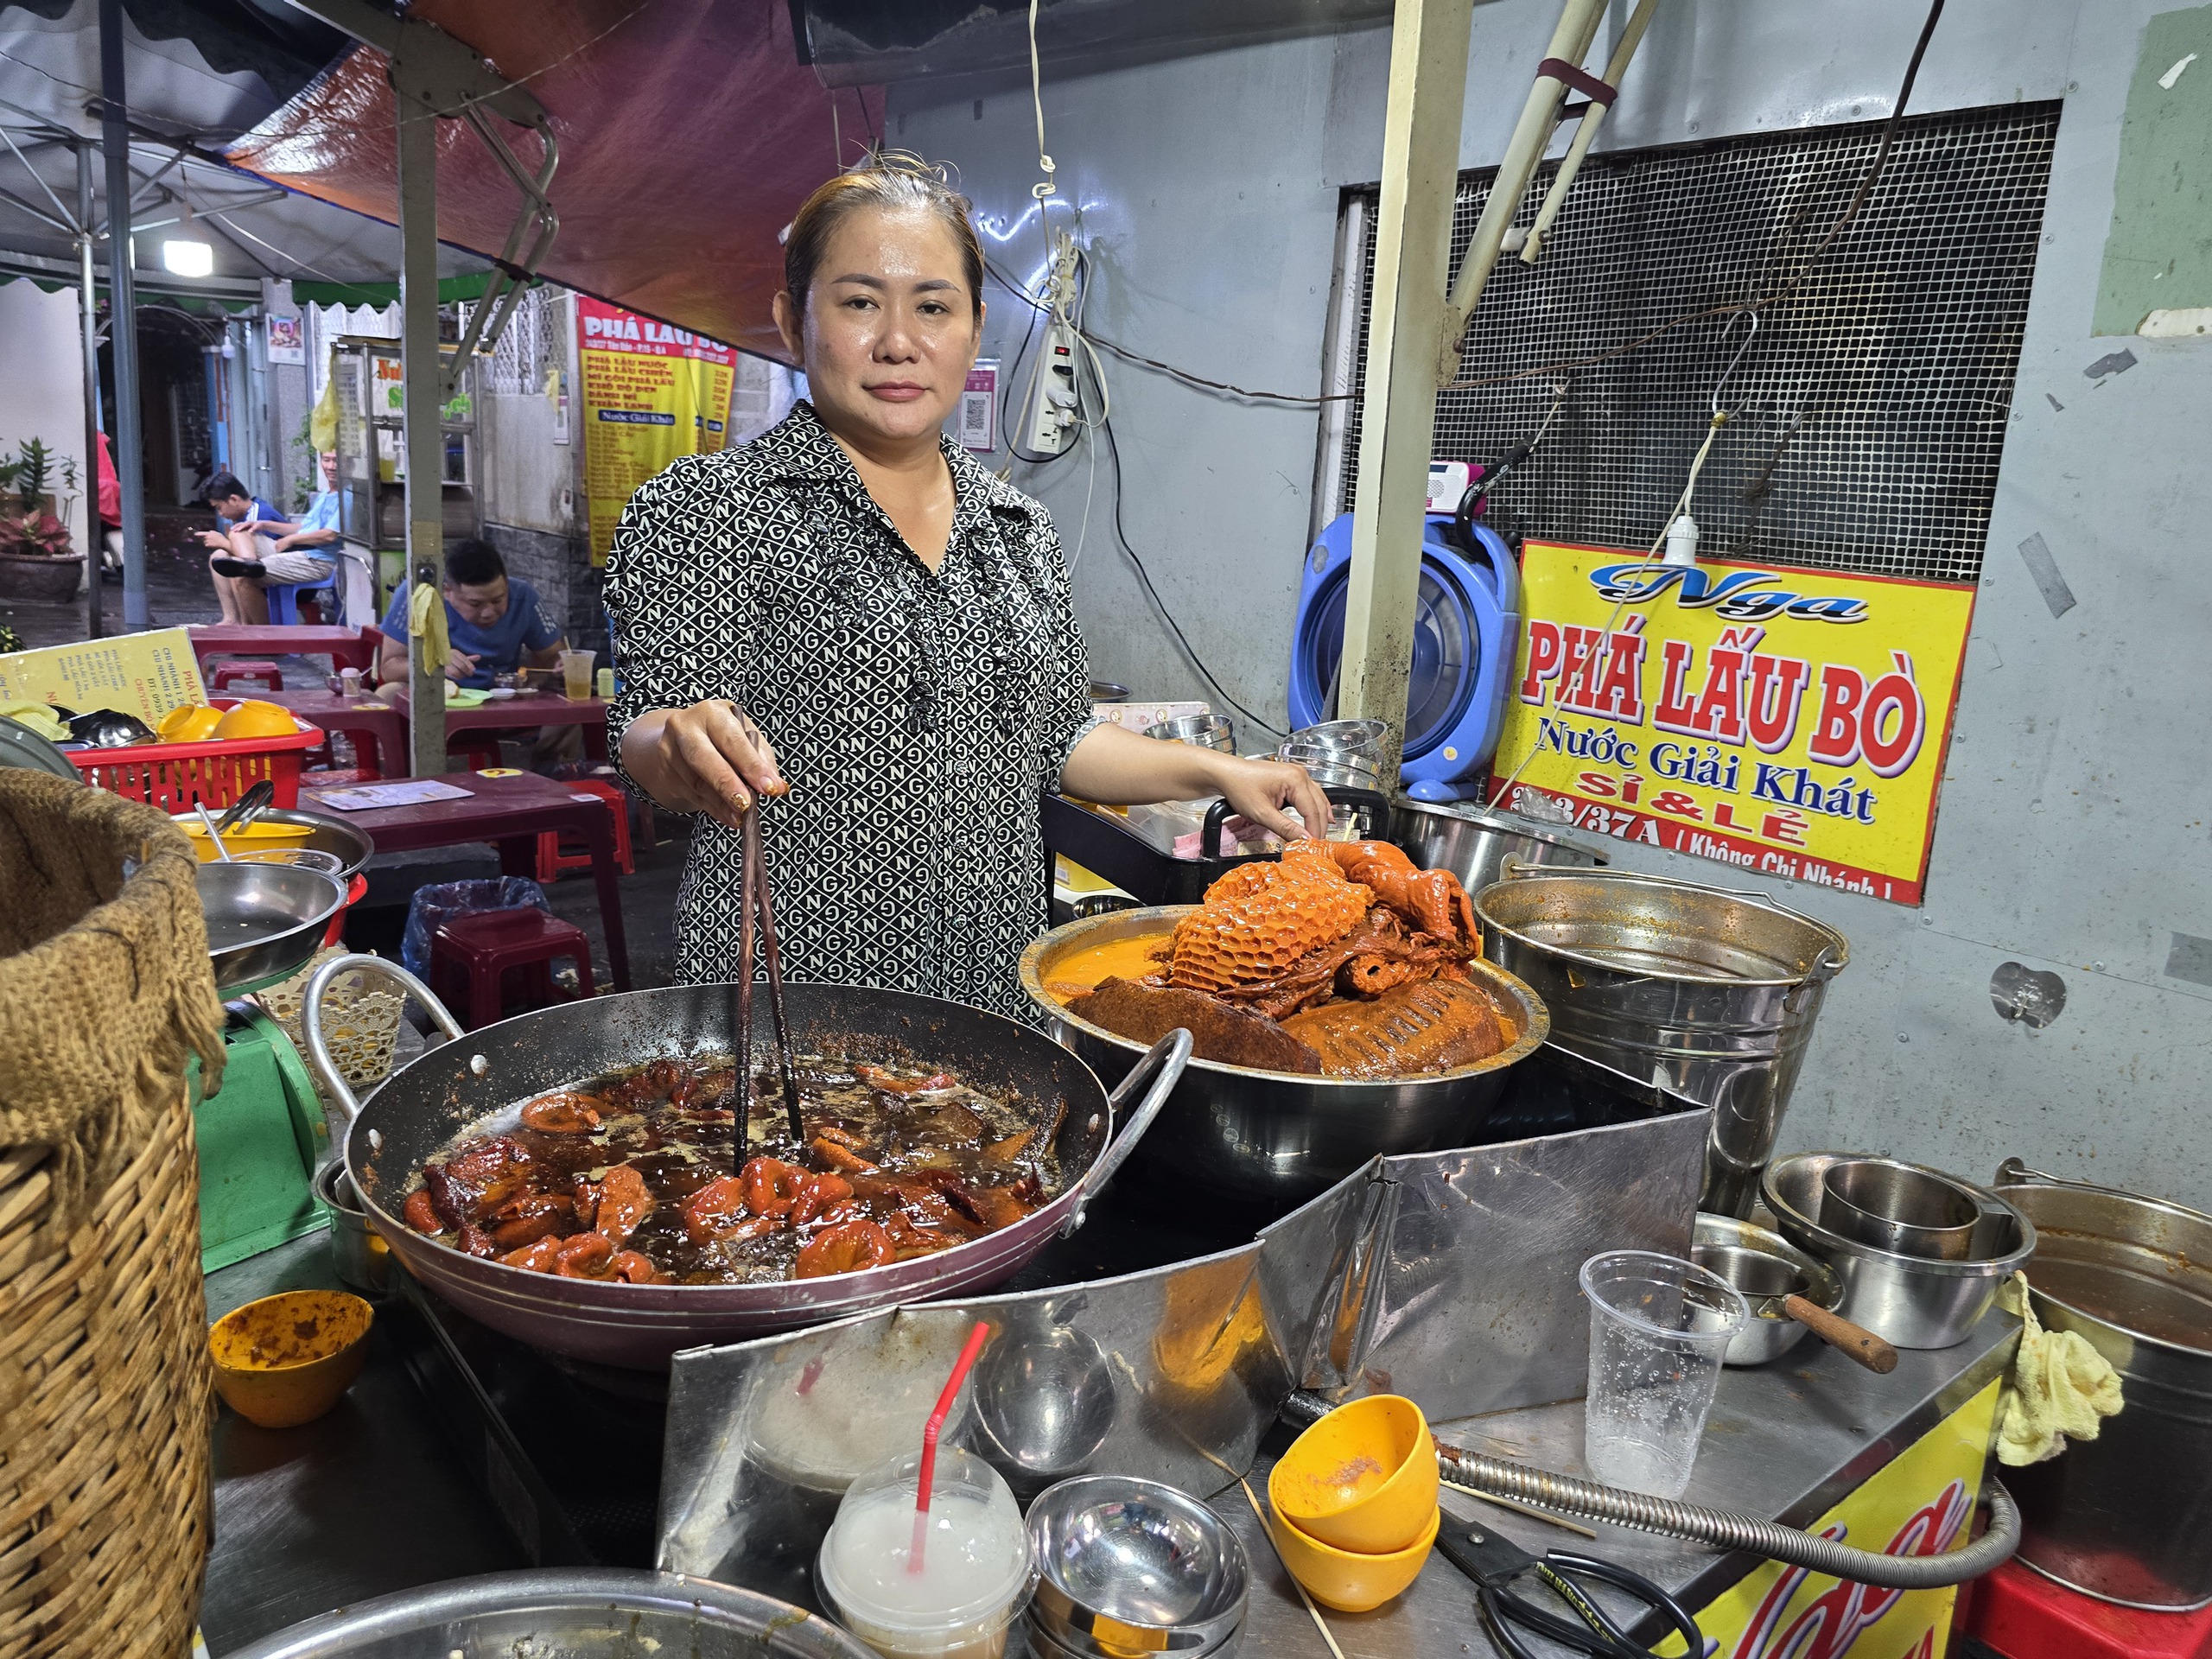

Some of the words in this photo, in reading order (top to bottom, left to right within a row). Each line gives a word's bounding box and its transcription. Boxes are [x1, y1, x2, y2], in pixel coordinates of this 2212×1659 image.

[584, 315, 641, 340] PHÁ
[1588, 563, 1870, 623] Nga
[1521, 613, 1647, 726] PHÁ
[1653, 624, 1810, 752] LẤU
[1808, 649, 1926, 779] BÒ
[1534, 717, 1638, 768] Nước
[1650, 743, 1739, 794] Giải
[1751, 761, 1877, 824] Khát
[1713, 808, 1811, 849] LẺ
[1689, 832, 1756, 866] Không
[1802, 861, 1874, 896] Nhánh
